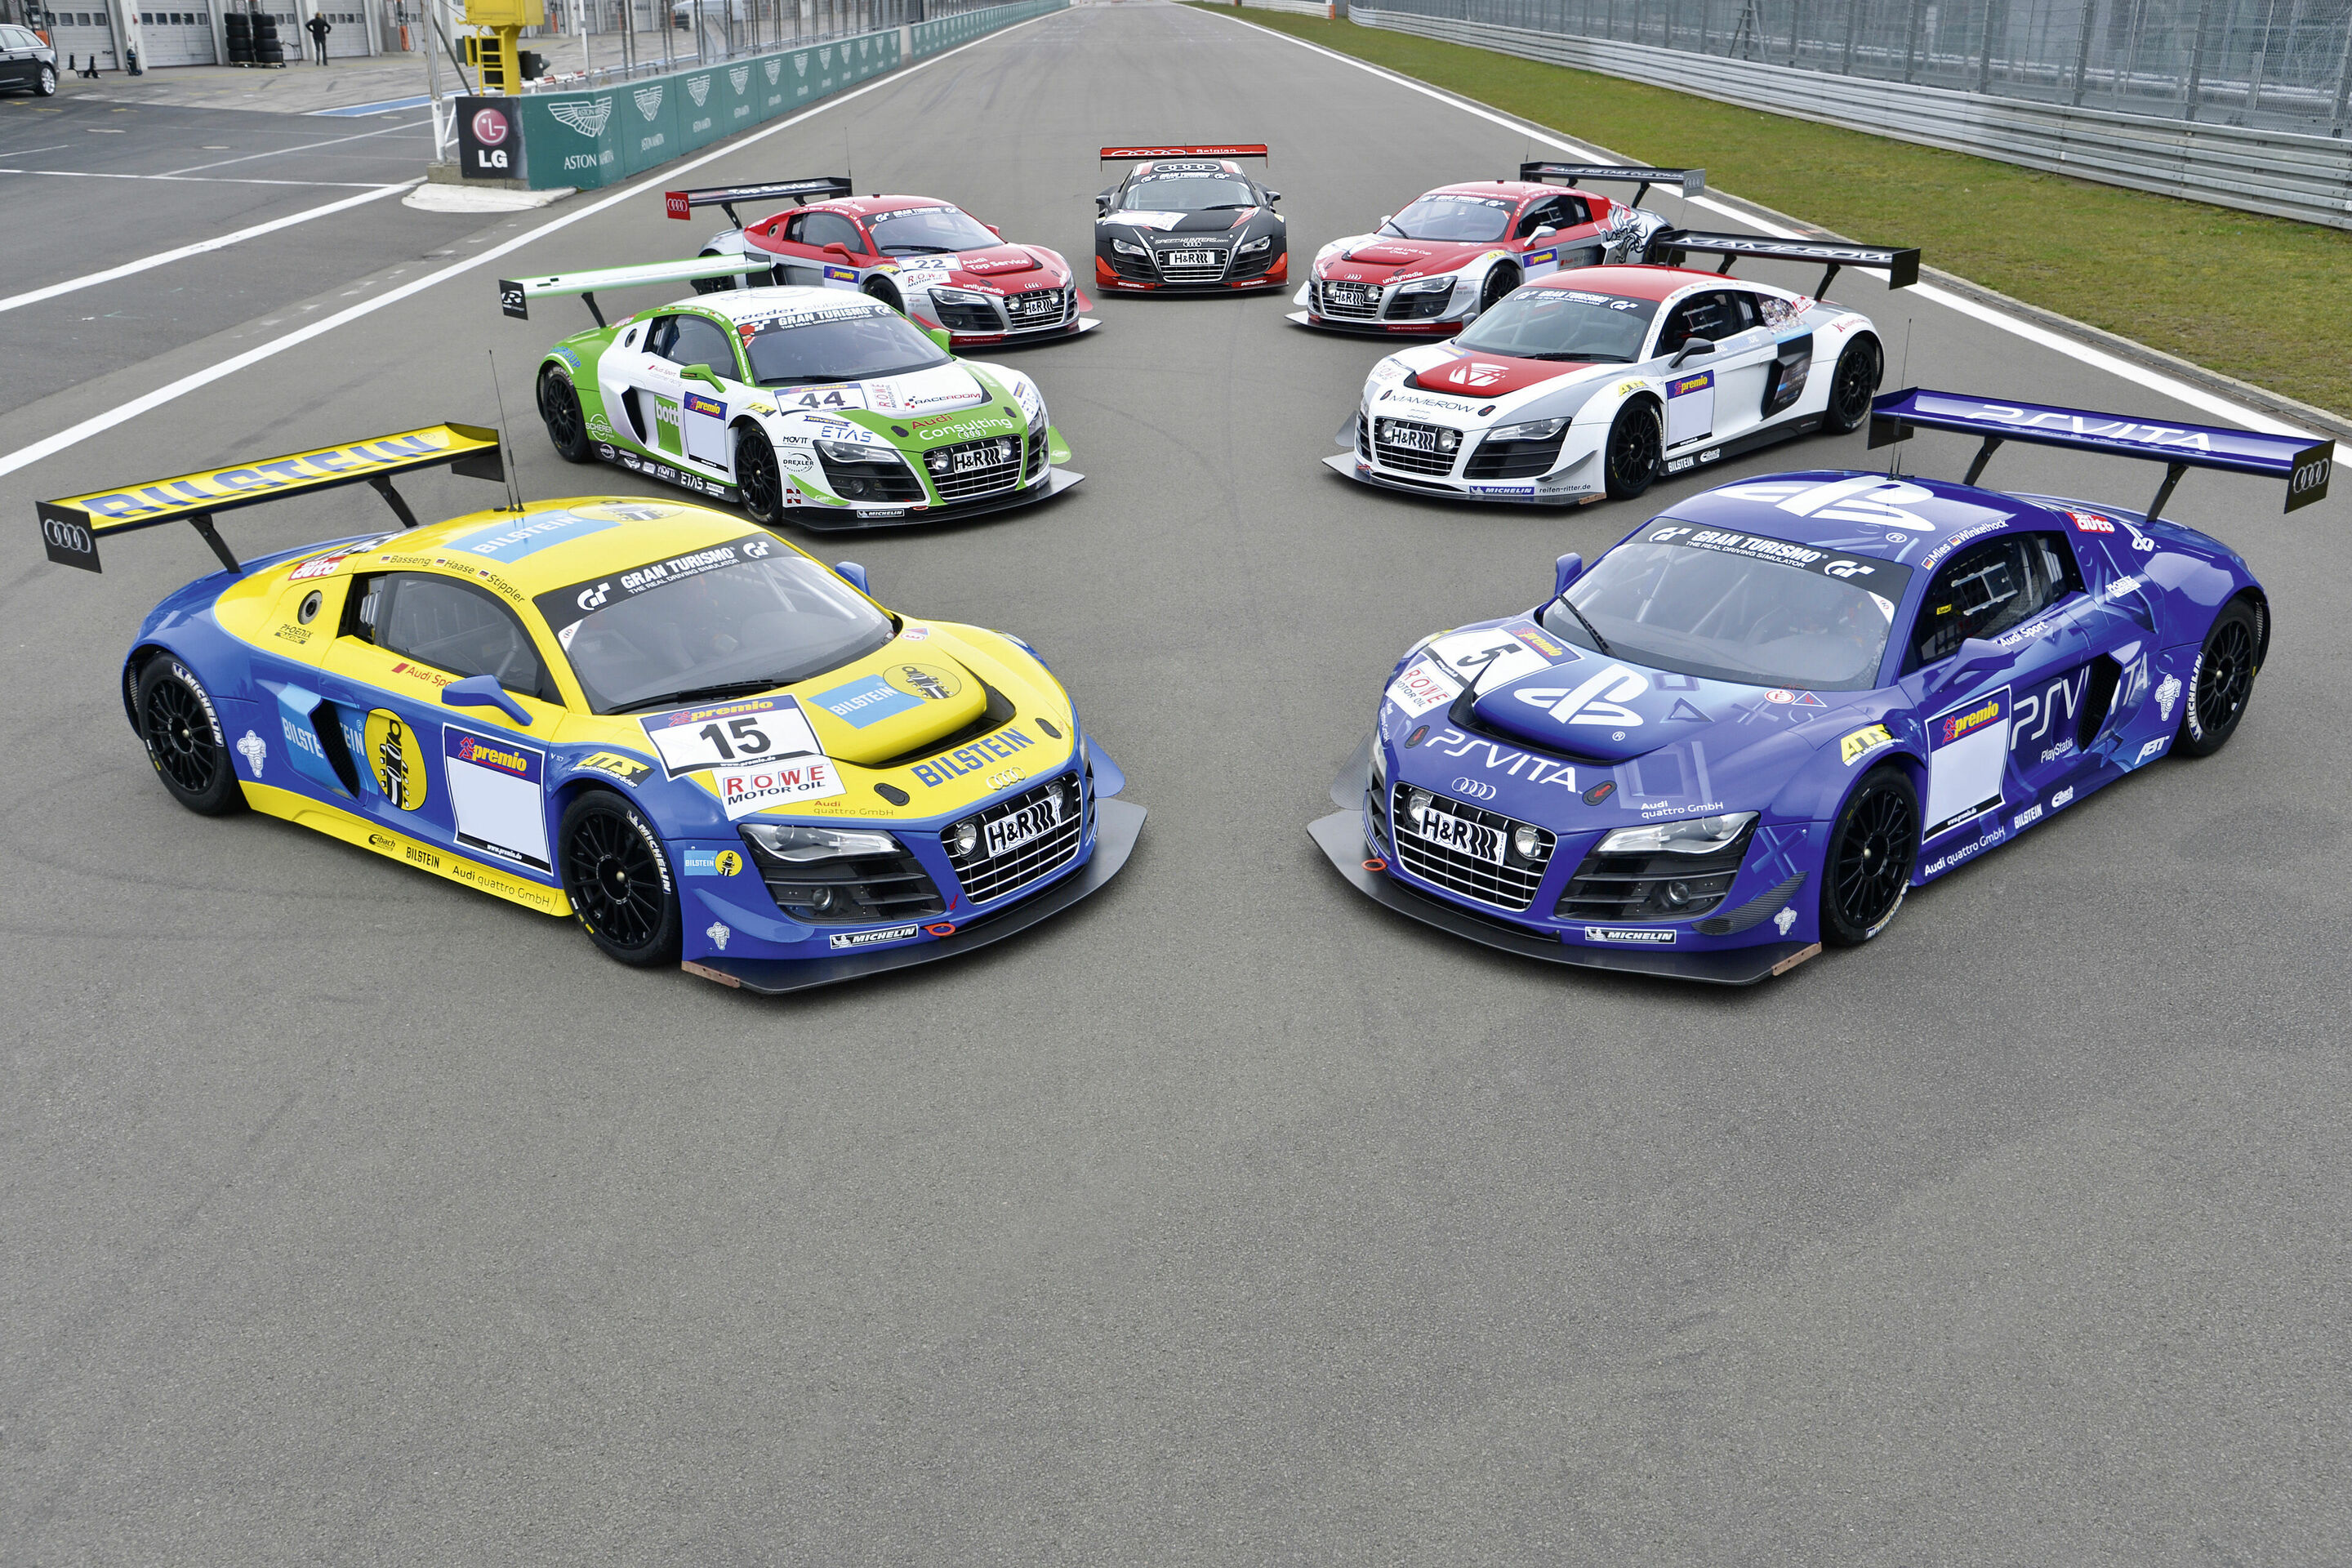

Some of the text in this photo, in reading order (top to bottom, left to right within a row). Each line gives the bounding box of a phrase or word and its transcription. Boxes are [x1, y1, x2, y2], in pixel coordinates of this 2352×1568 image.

[479, 150, 508, 168] LG
[564, 153, 597, 170] ASTON
[915, 259, 946, 269] 22
[963, 257, 988, 265] Audi
[967, 259, 1029, 270] Top Service
[1174, 254, 1195, 263] H&R
[1383, 271, 1423, 283] unitymedia
[963, 283, 1004, 294] unitymedia
[1334, 291, 1352, 305] H&R
[732, 306, 798, 323] raeder
[777, 306, 871, 327] GRAN TURISMO
[1025, 301, 1045, 314] H&R
[1681, 376, 1708, 393] premio
[696, 399, 721, 415] premio
[799, 391, 846, 408] 44
[915, 392, 981, 405] RACEROOM
[1389, 394, 1476, 413] MAMEROW
[911, 413, 953, 430] Audi
[920, 417, 1013, 441] Consulting
[822, 425, 873, 443] ETAS
[1392, 428, 1417, 444] H&R
[955, 450, 985, 472] H&R
[1668, 456, 1695, 473] BILSTEIN
[80, 434, 446, 520] BILSTEIN
[680, 471, 703, 491] ETAS
[1539, 483, 1591, 493] reifen-ritter.de
[470, 514, 583, 555] BILSTEIN
[1957, 519, 2008, 542] Winkelhock
[2076, 519, 2115, 532] auto
[1686, 540, 1806, 568] THE REAL DRIVING SIMULATOR
[1690, 530, 1822, 564] GRAN TURISMO
[1928, 542, 1951, 561] Mies
[290, 561, 341, 580] auto
[390, 555, 432, 567] Basseng
[444, 559, 476, 574] Haase
[620, 546, 736, 590] GRAN TURISMO
[628, 558, 740, 595] THE REAL DRIVING SIMULATOR
[487, 573, 525, 604] Stippler
[2000, 620, 2048, 647] Audi Sport
[1456, 643, 1522, 666] 5
[1518, 632, 1563, 657] premio
[406, 666, 452, 688] Audi Spo
[1403, 669, 1449, 704] ROWE
[828, 684, 896, 716] BILSTEIN
[2188, 653, 2203, 727] MICHELIN
[184, 671, 221, 747] MICHELIN
[690, 701, 774, 722] premio
[1953, 702, 1999, 737] premio
[699, 717, 771, 760] 15
[473, 743, 528, 773] premio
[911, 726, 1036, 788] BILSTEIN
[2135, 737, 2166, 765] ABT
[719, 755, 776, 768] www.premio.de
[724, 765, 826, 796] ROWE
[728, 781, 826, 805] MOTOR OIL
[813, 808, 894, 817] quattro GmbH
[1641, 800, 1668, 810] Audi
[1641, 801, 1724, 819] quattro GmbH
[2014, 804, 2043, 830] BILSTEIN
[987, 810, 1034, 854] H&R
[1421, 808, 1468, 849] H&R
[368, 833, 397, 849] Eibach
[1924, 826, 2005, 876] Audi quattro GmbH
[405, 846, 440, 869] BILSTEIN
[638, 823, 671, 896] MICHELIN
[684, 858, 715, 867] BILSTEIN
[452, 865, 550, 907] Audi quattro GmbH
[851, 928, 915, 945] MICHELIN
[1607, 931, 1674, 942] MICHELIN
